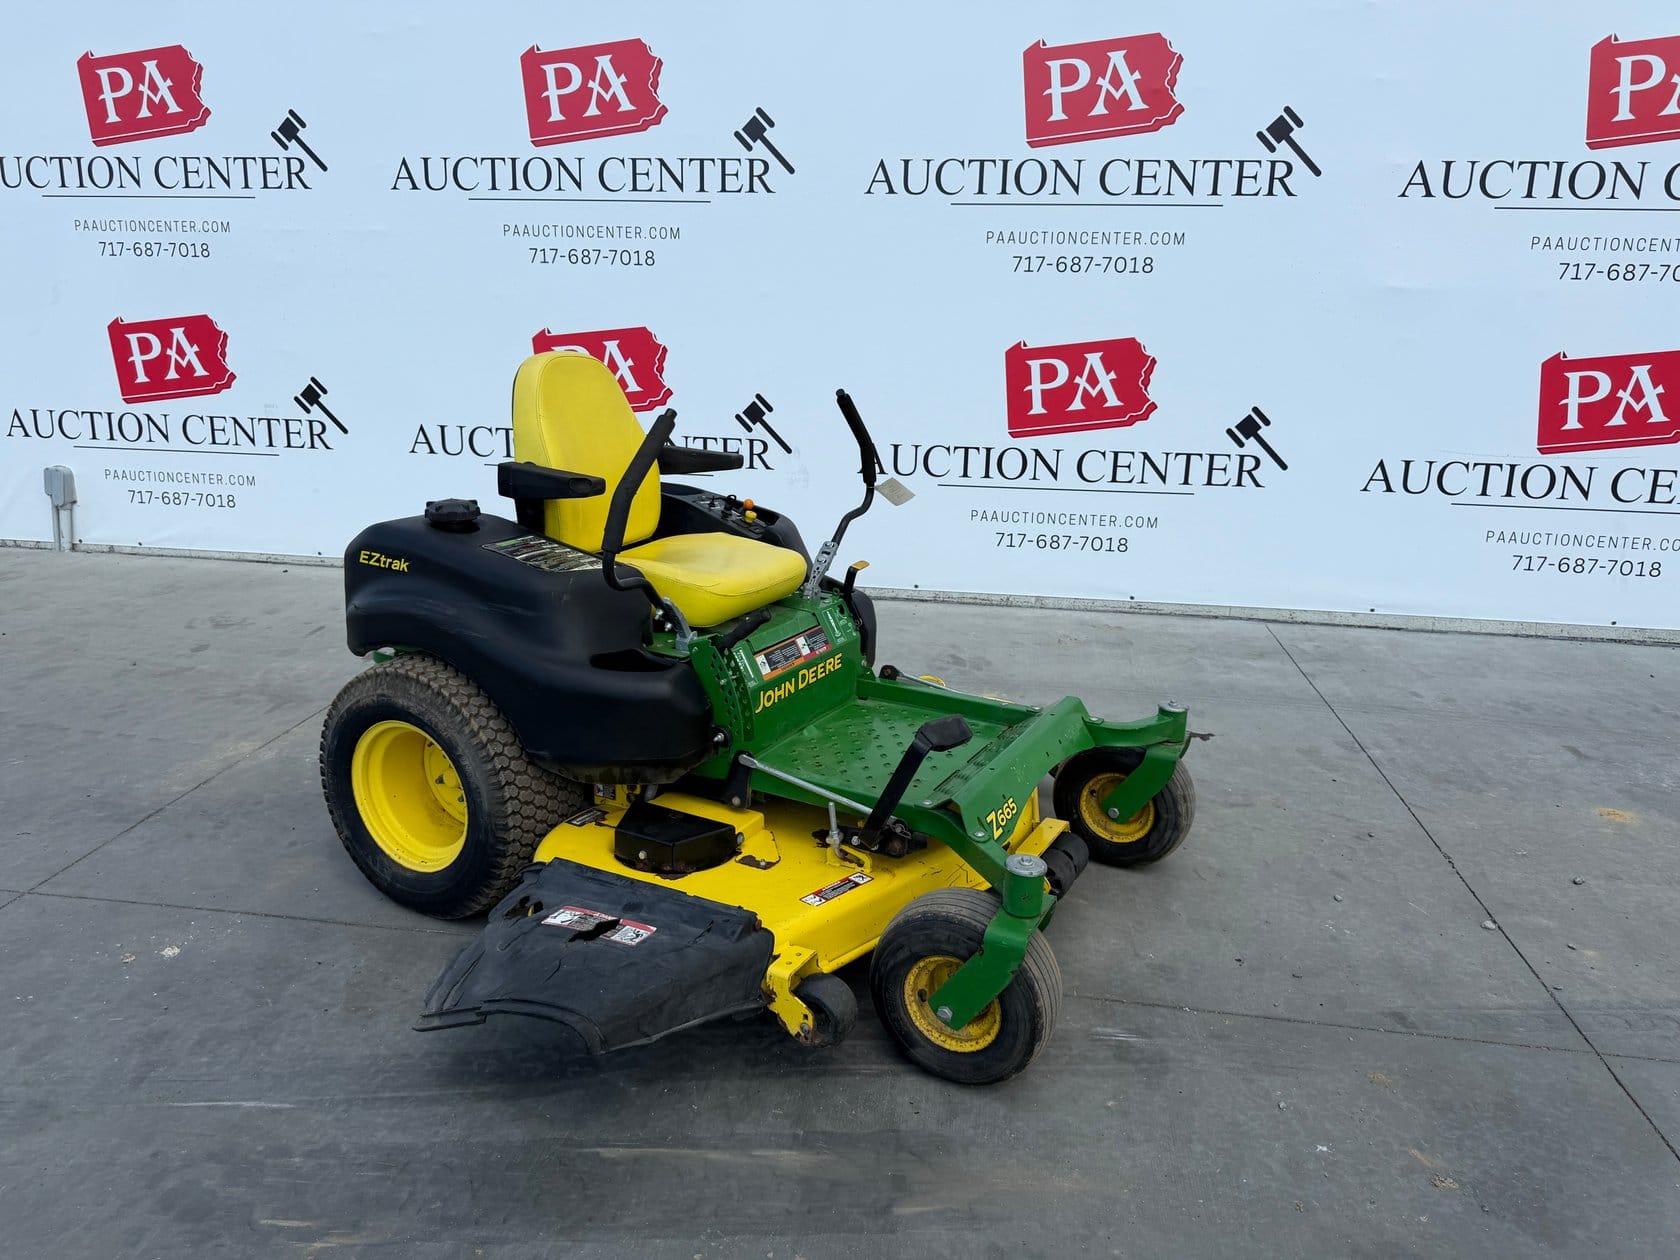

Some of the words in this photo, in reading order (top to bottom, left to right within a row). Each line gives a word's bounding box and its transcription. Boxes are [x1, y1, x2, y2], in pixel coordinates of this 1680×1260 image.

[95, 59, 183, 124] PA
[540, 54, 637, 123] PA
[1042, 49, 1149, 122] PA
[0, 155, 142, 190] UCTION
[153, 155, 313, 190] CENTER
[390, 156, 586, 193] AUCTION
[597, 156, 777, 194] CENTER
[863, 158, 1087, 197] AUCTION
[1098, 158, 1299, 198] CENTER
[1396, 159, 1652, 201] AUCTION
[73, 219, 231, 234] PAAUCTIONCENTER.COM
[502, 223, 681, 240] PAAUCTIONCENTER.COM
[985, 230, 1186, 246] PAAUCTIONCENTER.COM
[97, 241, 211, 259] 717-687-7018
[528, 247, 656, 267] 717-687-7018
[1012, 255, 1154, 274] 717-687-7018
[125, 328, 209, 384] PA
[551, 340, 643, 393] A
[1023, 352, 1124, 415] PA
[1559, 364, 1671, 430] PA
[6, 407, 171, 444] AUCTION
[181, 413, 334, 451] CENTER
[104, 468, 256, 487] PAAUCTIONCENTER.COM
[1076, 448, 1266, 489] CENTER
[1359, 458, 1599, 502] AUCTION
[127, 489, 237, 509] 717-687-7018
[970, 509, 1159, 529] PAAUCTIONCENTER.COM
[995, 531, 1129, 553] 717-687-7018
[1485, 529, 1680, 552] PAAUCTIONCENTER.CO
[359, 550, 410, 573] EZtrak
[1512, 554, 1662, 578] 717-687-7018
[755, 678, 795, 714] JOHN
[798, 653, 843, 690] DEERE
[986, 797, 1018, 841] Z665
